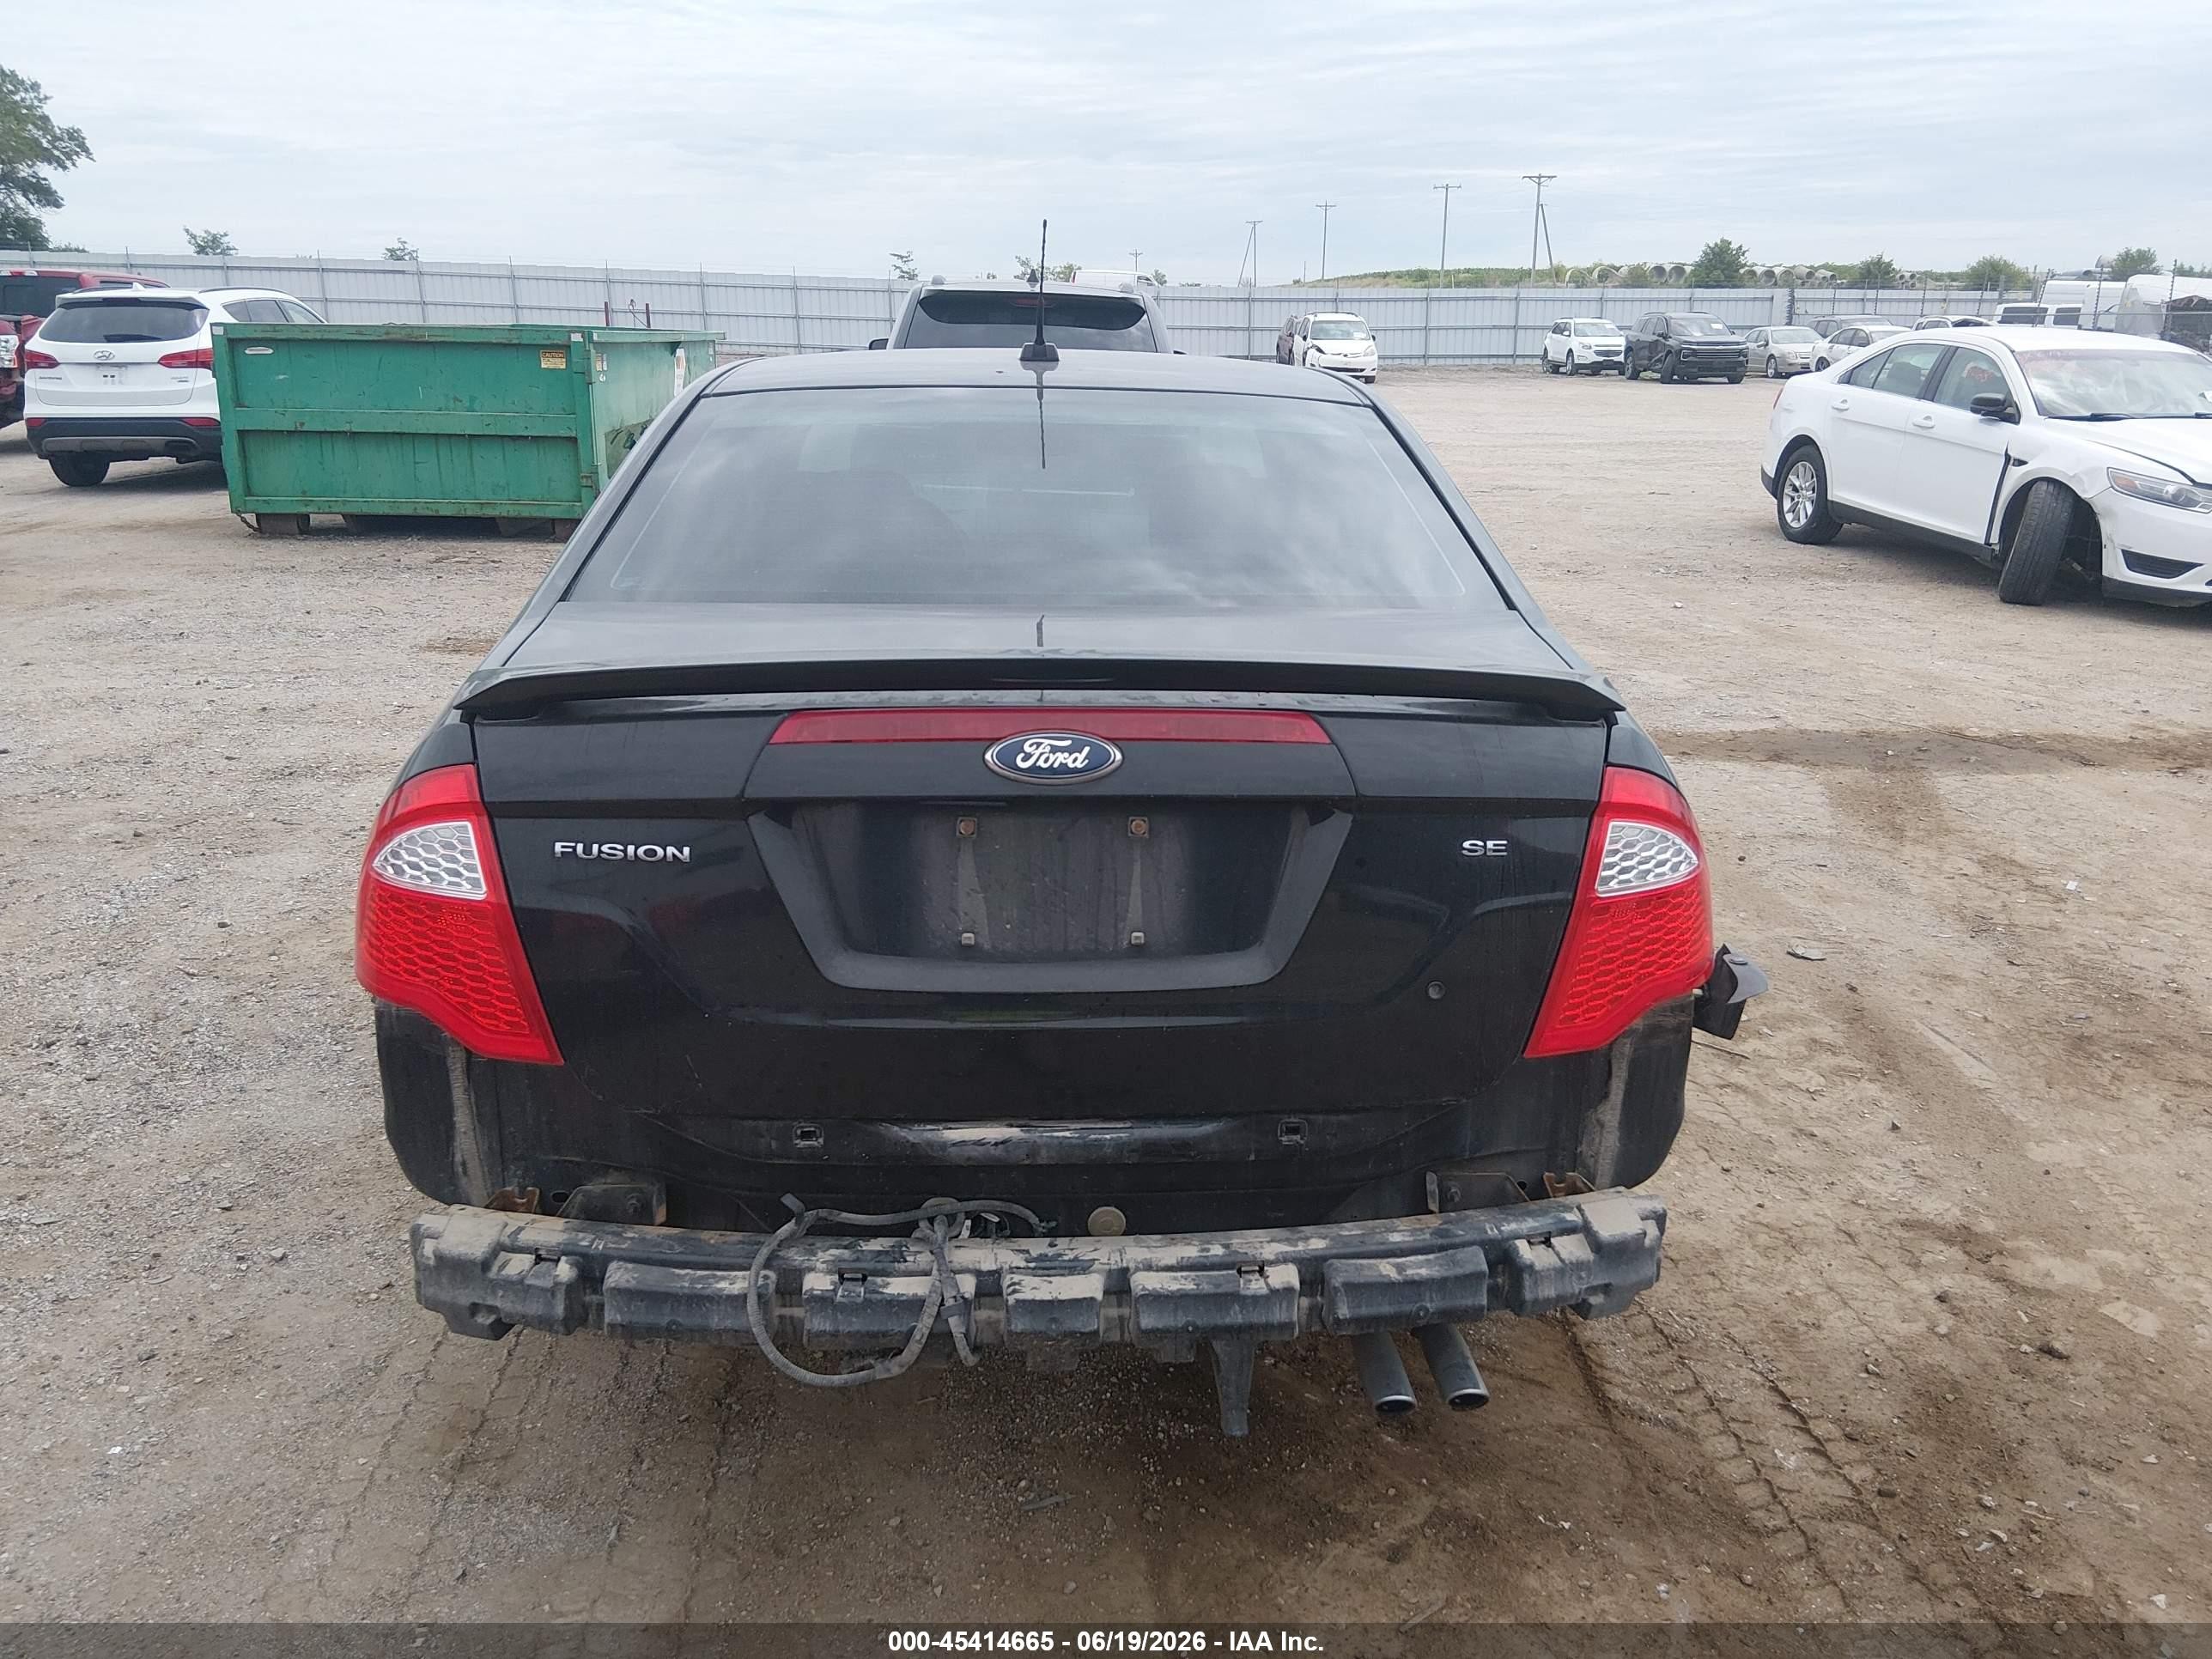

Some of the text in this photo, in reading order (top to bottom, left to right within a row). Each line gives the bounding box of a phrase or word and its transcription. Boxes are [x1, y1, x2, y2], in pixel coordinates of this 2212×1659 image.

[1015, 738, 1091, 769] Ford
[554, 842, 691, 863] FUSION
[1462, 840, 1508, 856] SE
